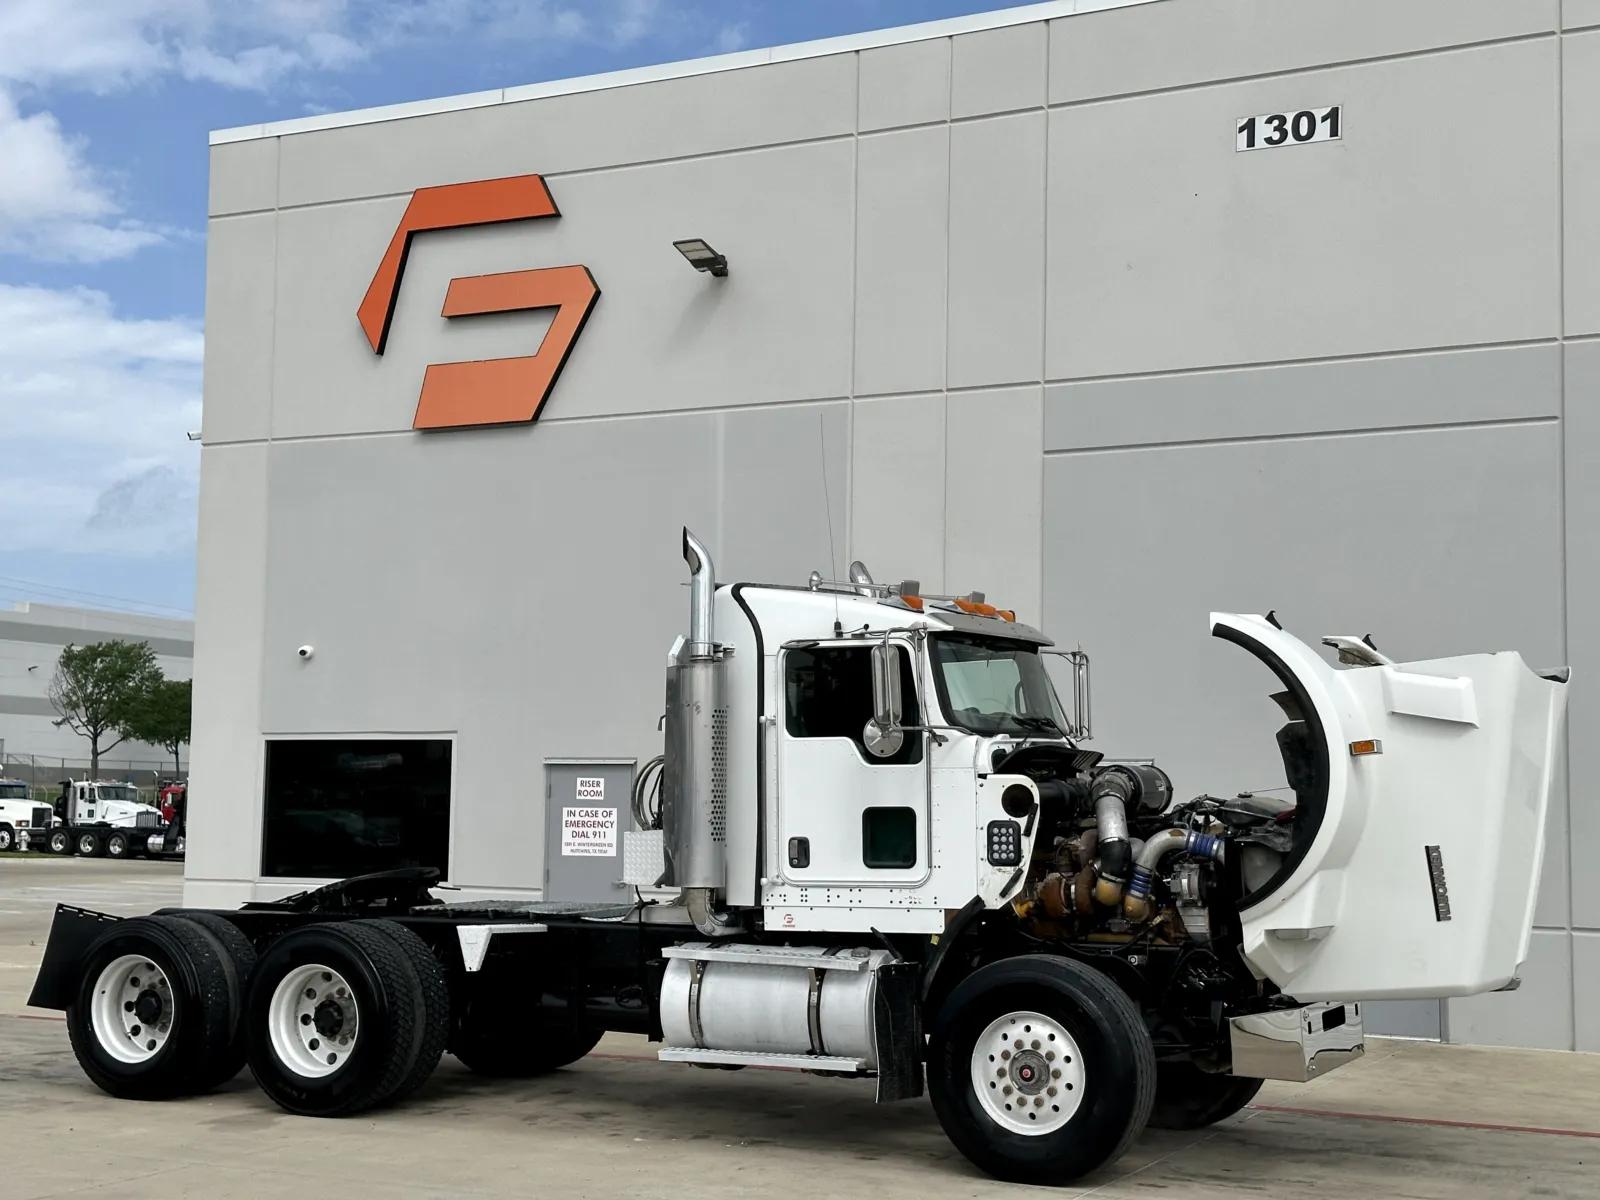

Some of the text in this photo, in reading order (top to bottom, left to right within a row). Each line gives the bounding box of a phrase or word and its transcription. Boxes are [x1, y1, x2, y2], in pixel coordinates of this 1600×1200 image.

[1238, 106, 1339, 148] 1301
[580, 780, 601, 788] RISER
[577, 789, 603, 797] ROOM
[567, 809, 613, 818] IN CASE OF
[564, 820, 615, 829] EMERGENCY
[571, 831, 606, 839] DIAL 911
[1427, 845, 1451, 921] KENWORTH
